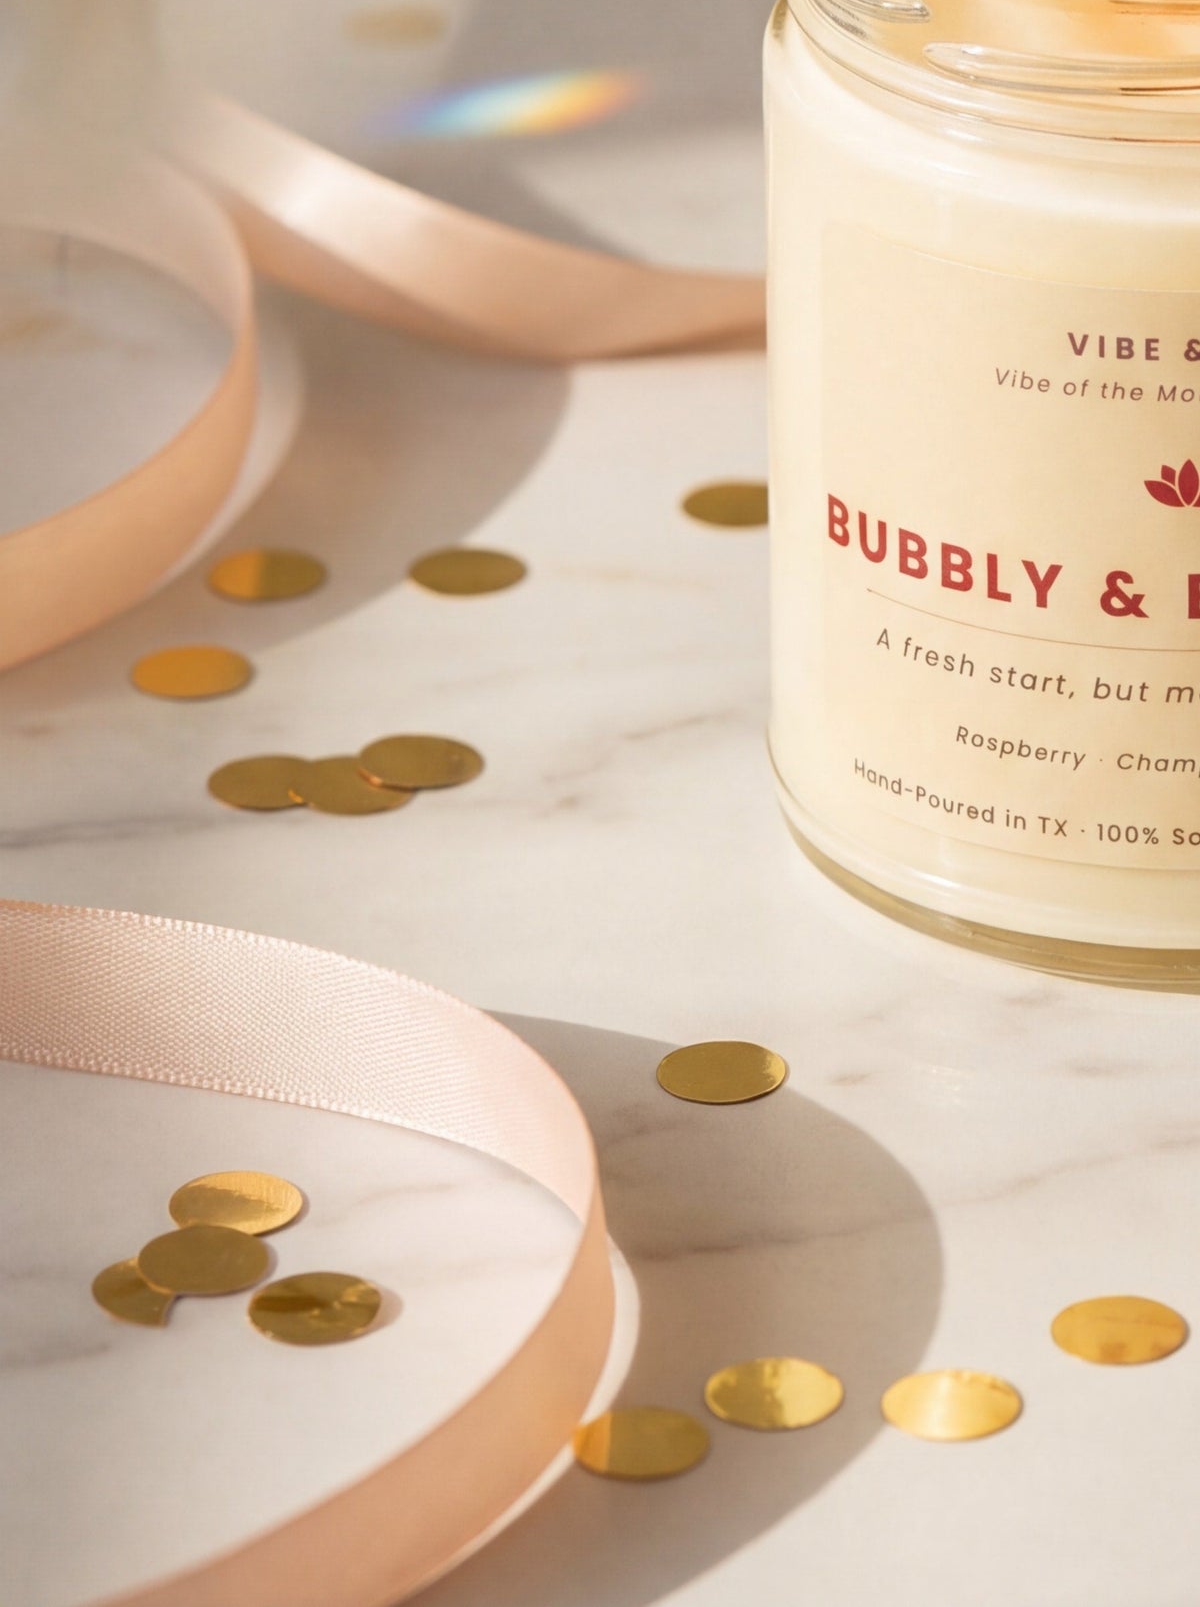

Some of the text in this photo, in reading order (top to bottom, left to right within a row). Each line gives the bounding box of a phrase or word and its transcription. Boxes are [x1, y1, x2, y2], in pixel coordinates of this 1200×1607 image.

[1066, 331, 1160, 361] VIBE
[995, 367, 1051, 394] Vibe
[1062, 378, 1090, 398] of
[1100, 381, 1144, 402] the
[827, 493, 1063, 609] BUBBLY
[1099, 570, 1149, 619] &
[875, 627, 891, 651] A
[902, 636, 975, 678] fresh
[989, 666, 1075, 700] start,
[1092, 677, 1150, 703] but
[853, 757, 995, 825] Hand-Poured
[1005, 808, 1027, 831] in
[1037, 815, 1068, 838] TX
[1096, 823, 1160, 846] 100%
